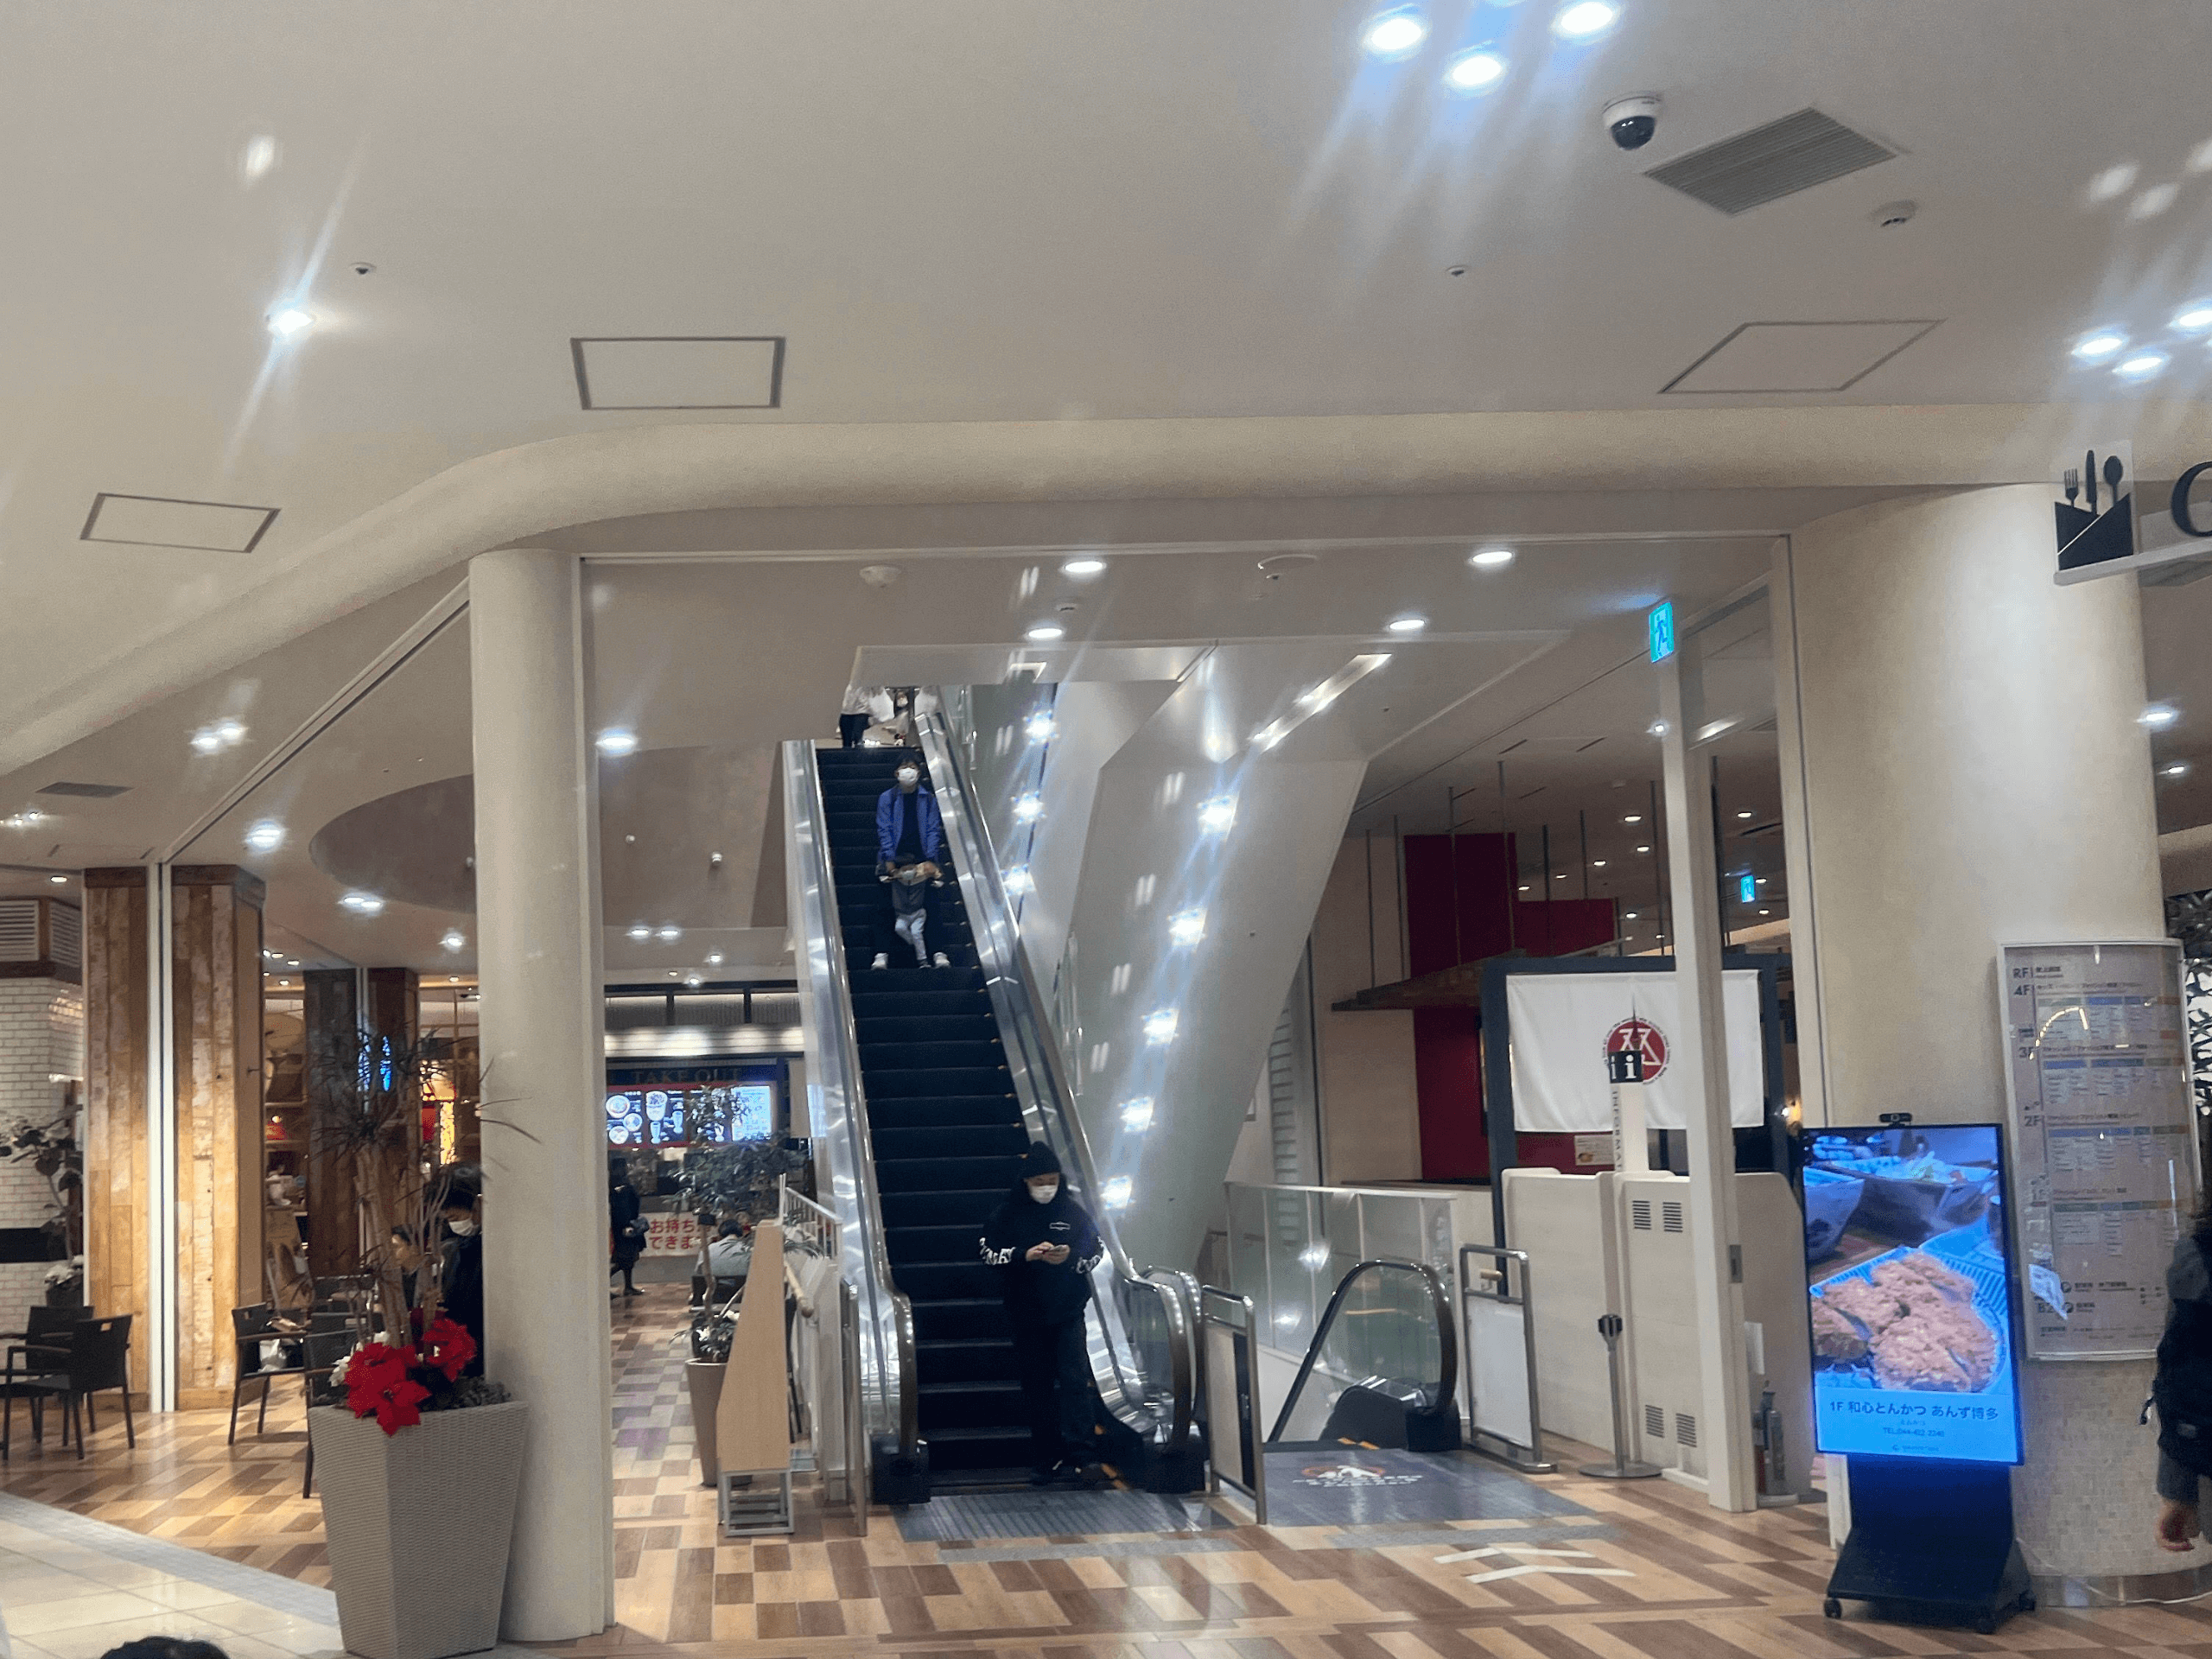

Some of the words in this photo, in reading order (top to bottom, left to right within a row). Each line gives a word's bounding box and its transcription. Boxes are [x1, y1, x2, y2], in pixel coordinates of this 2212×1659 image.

[2014, 984, 2031, 995] 4F
[2024, 1115, 2042, 1127] 2F
[1830, 1401, 1844, 1411] 1F
[1848, 1401, 1927, 1416] 和心とんかつ
[1931, 1405, 1999, 1421] あんず博多
